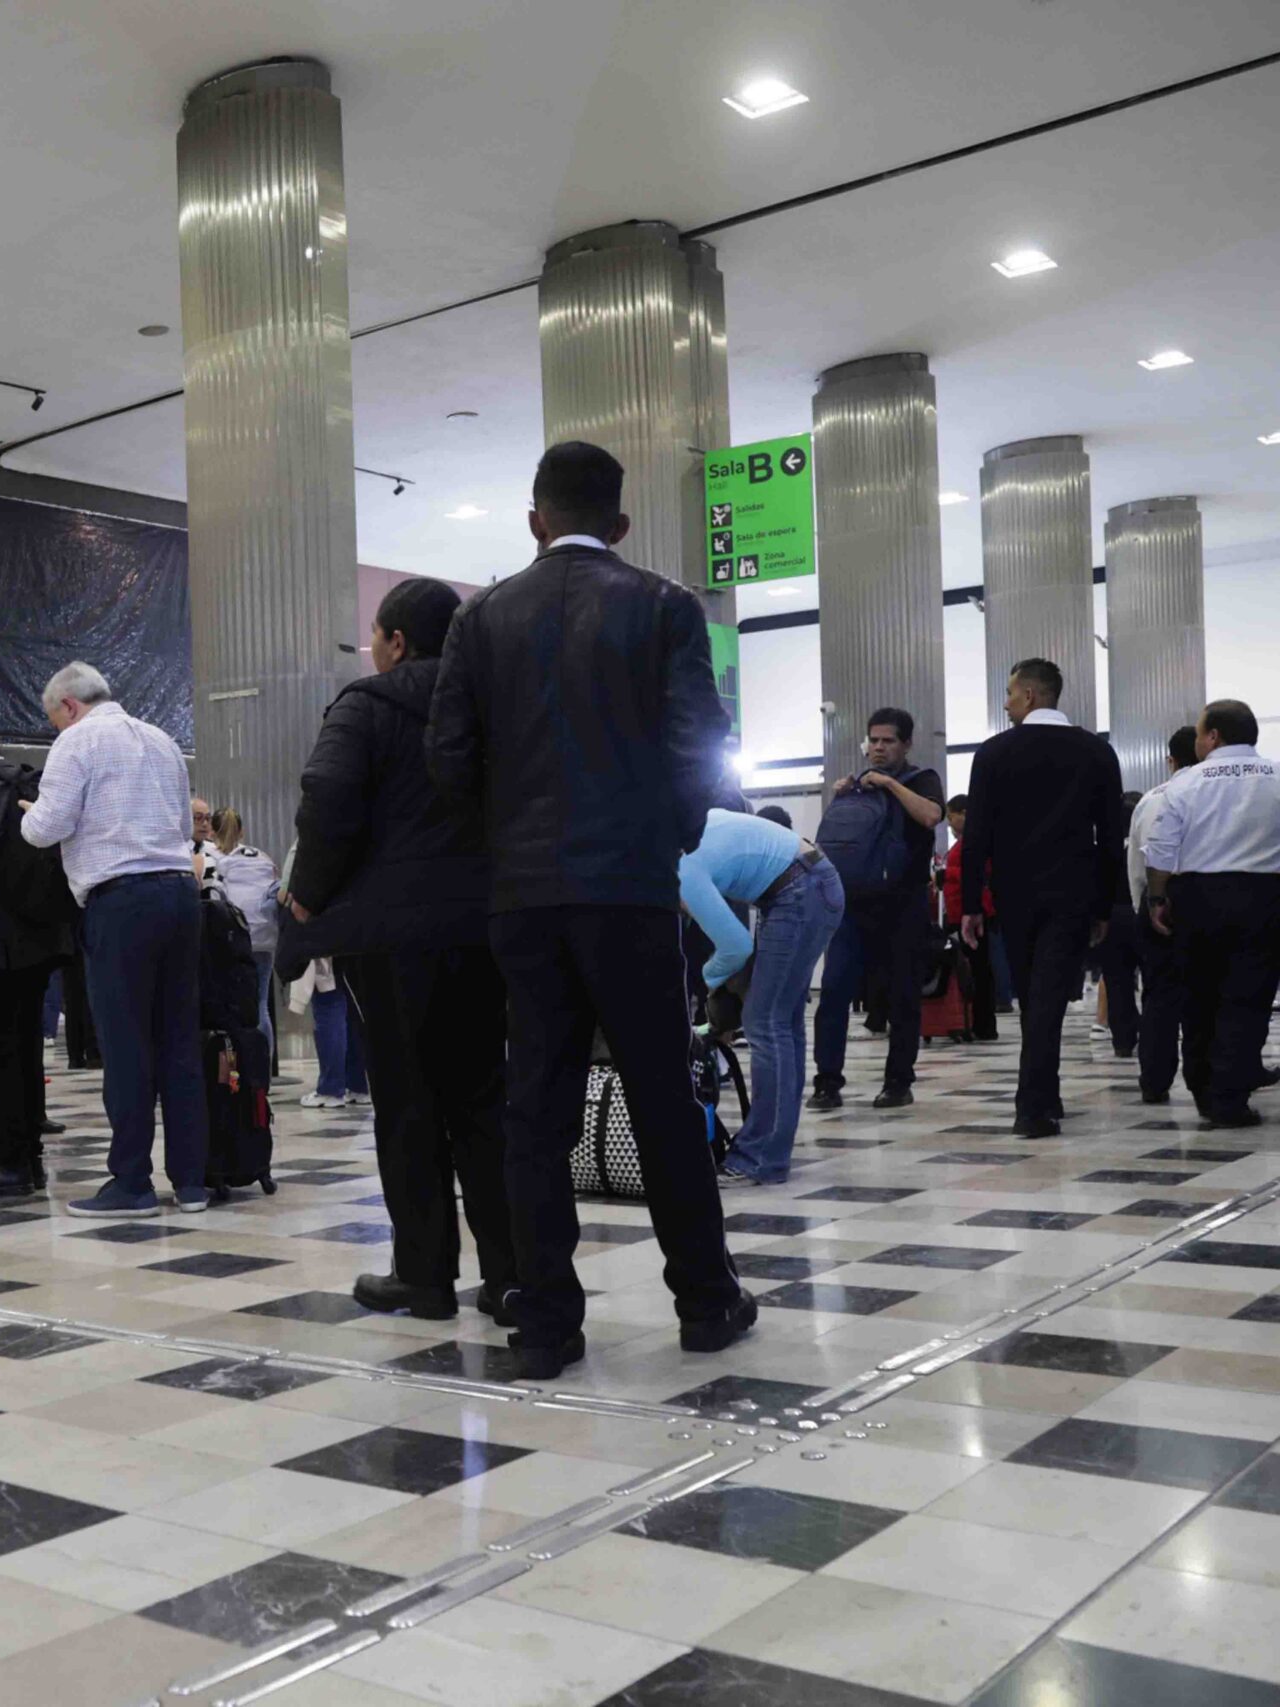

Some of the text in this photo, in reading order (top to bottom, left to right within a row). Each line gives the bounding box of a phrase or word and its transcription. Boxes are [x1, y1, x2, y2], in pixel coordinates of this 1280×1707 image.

[708, 453, 773, 484] Sala B
[735, 502, 765, 514] Salidas
[735, 532, 754, 543] Sala
[764, 551, 786, 561] Zona
[764, 556, 806, 570] comercial
[1202, 764, 1240, 778] SEGURIDAD
